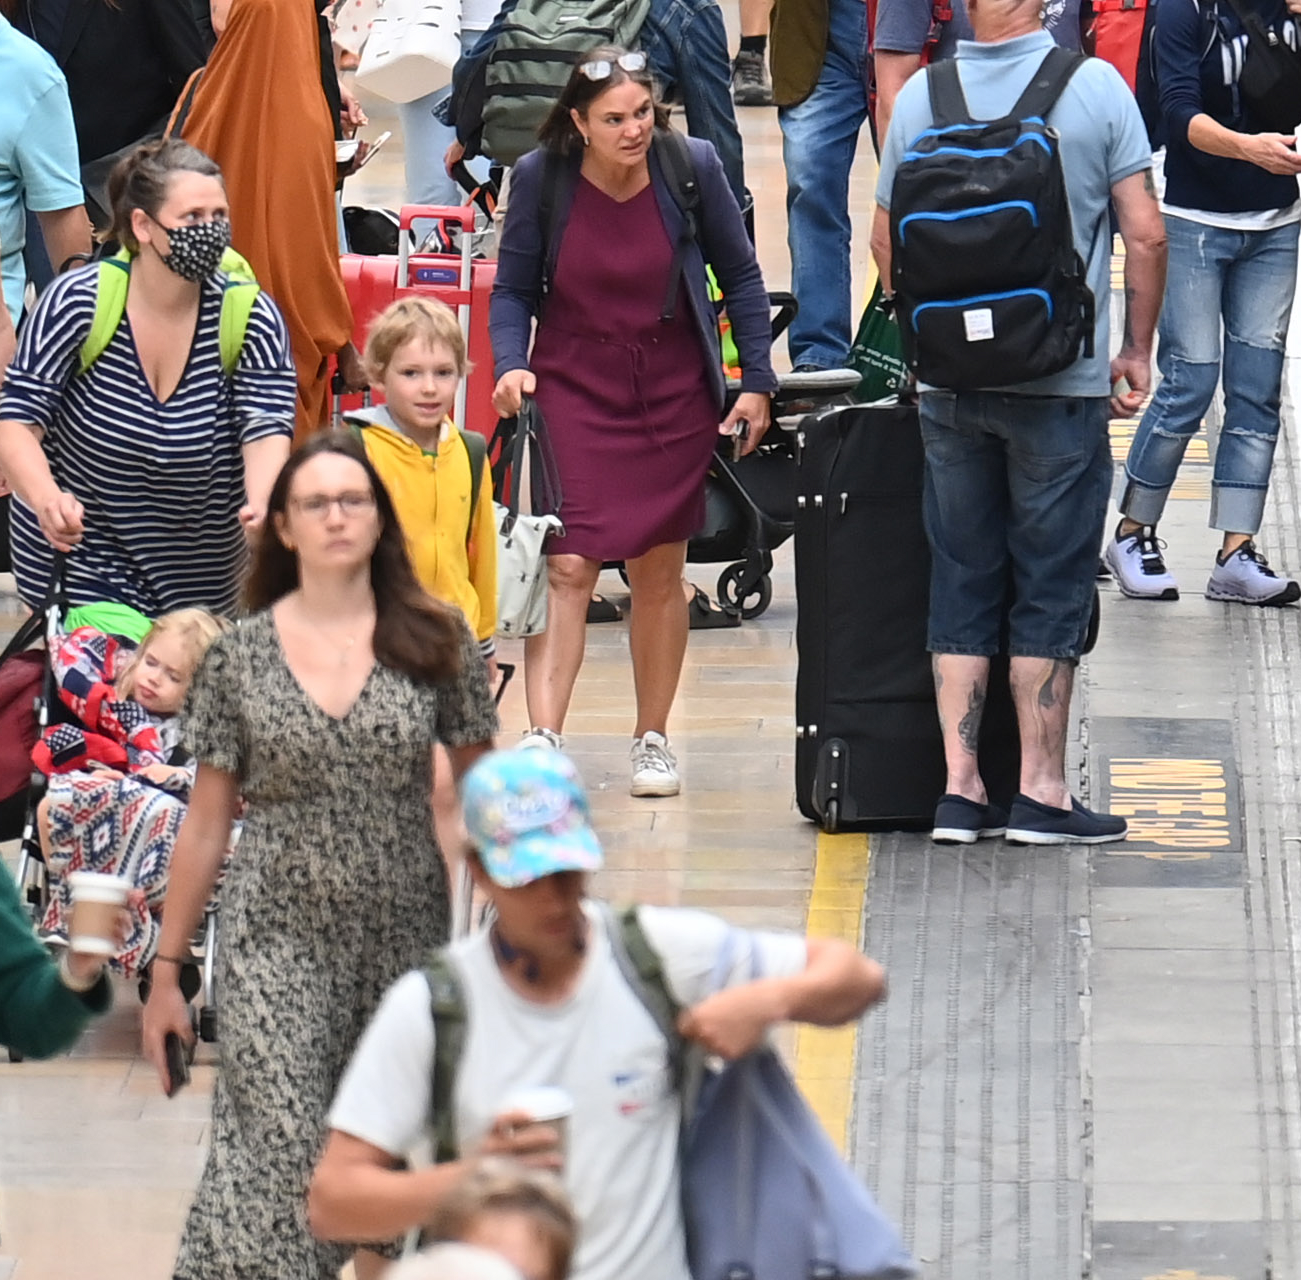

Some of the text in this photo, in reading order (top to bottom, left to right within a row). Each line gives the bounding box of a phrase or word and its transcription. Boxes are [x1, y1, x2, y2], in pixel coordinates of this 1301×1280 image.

[1109, 758, 1231, 848] MIND THE GAP
